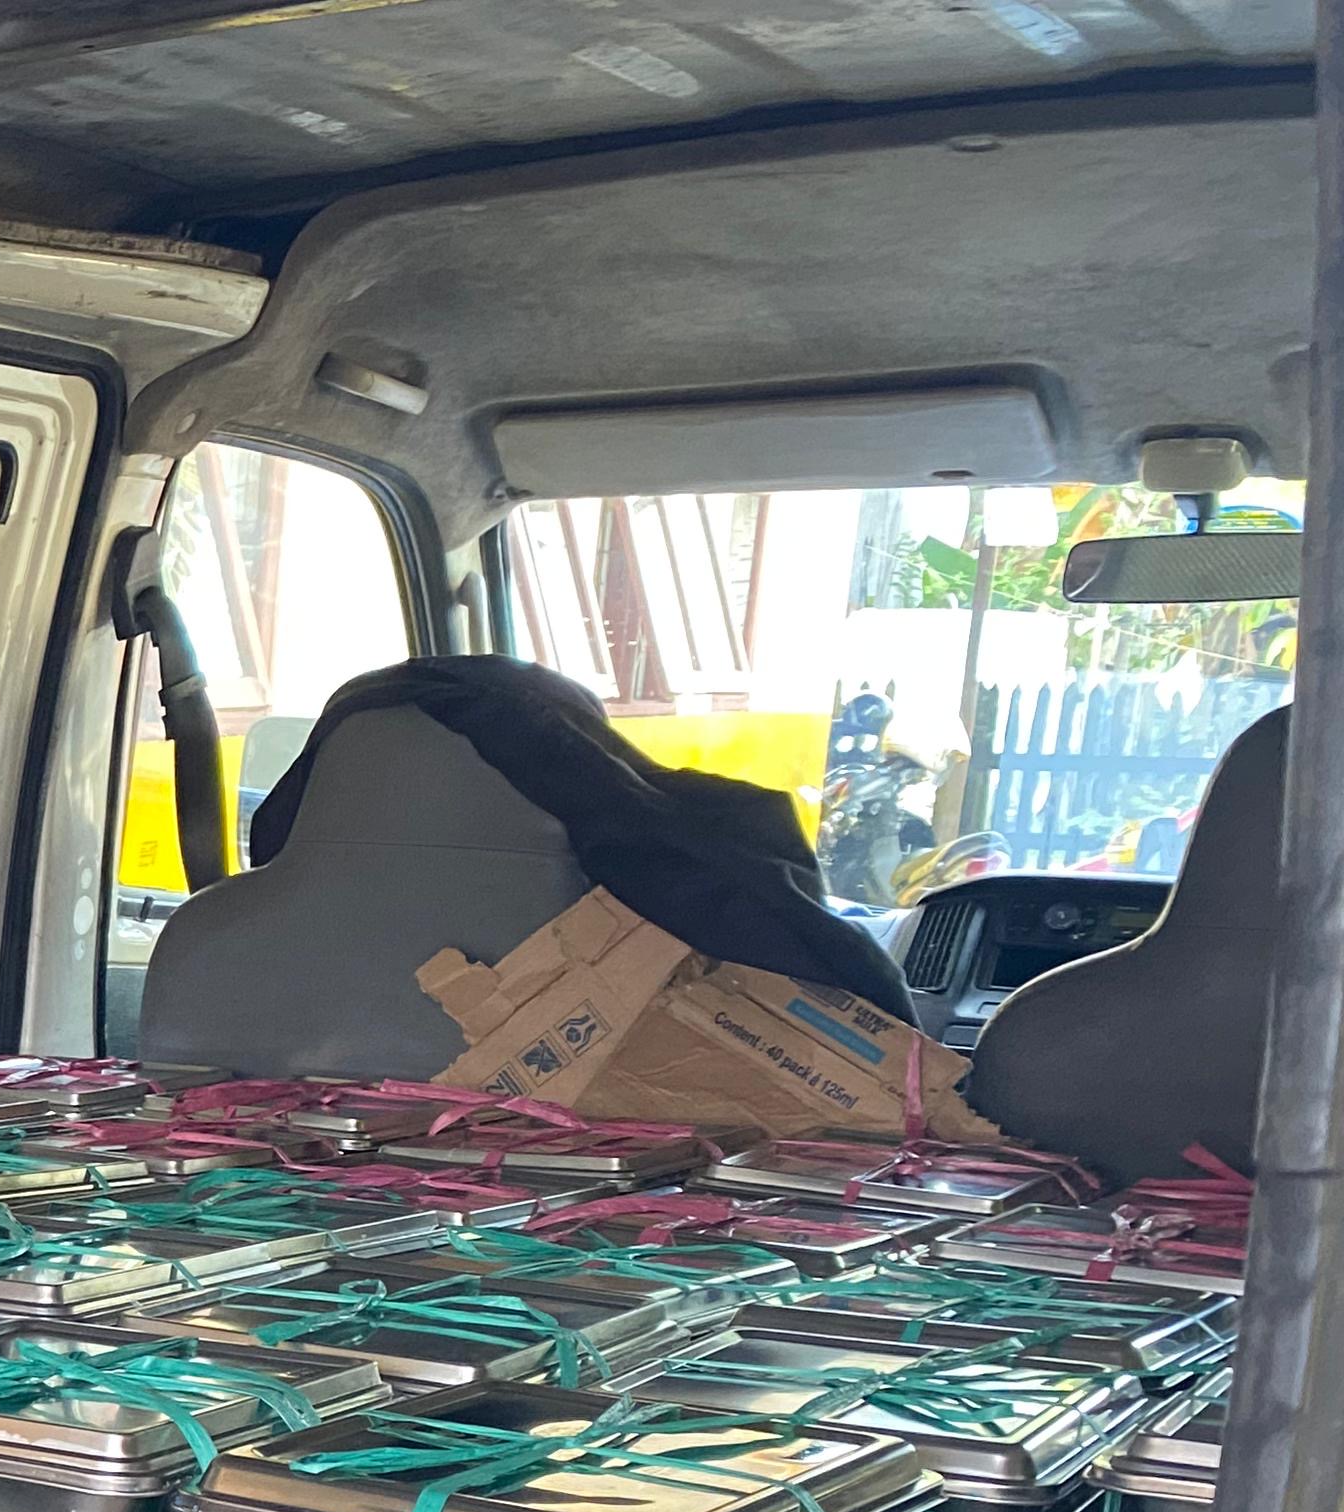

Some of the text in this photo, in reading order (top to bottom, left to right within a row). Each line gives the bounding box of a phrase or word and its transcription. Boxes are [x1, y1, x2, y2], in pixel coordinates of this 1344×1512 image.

[714, 1011, 762, 1048] Content
[766, 1045, 784, 1061] 40
[778, 1056, 813, 1080] pack
[820, 1079, 860, 1110] 125ml
